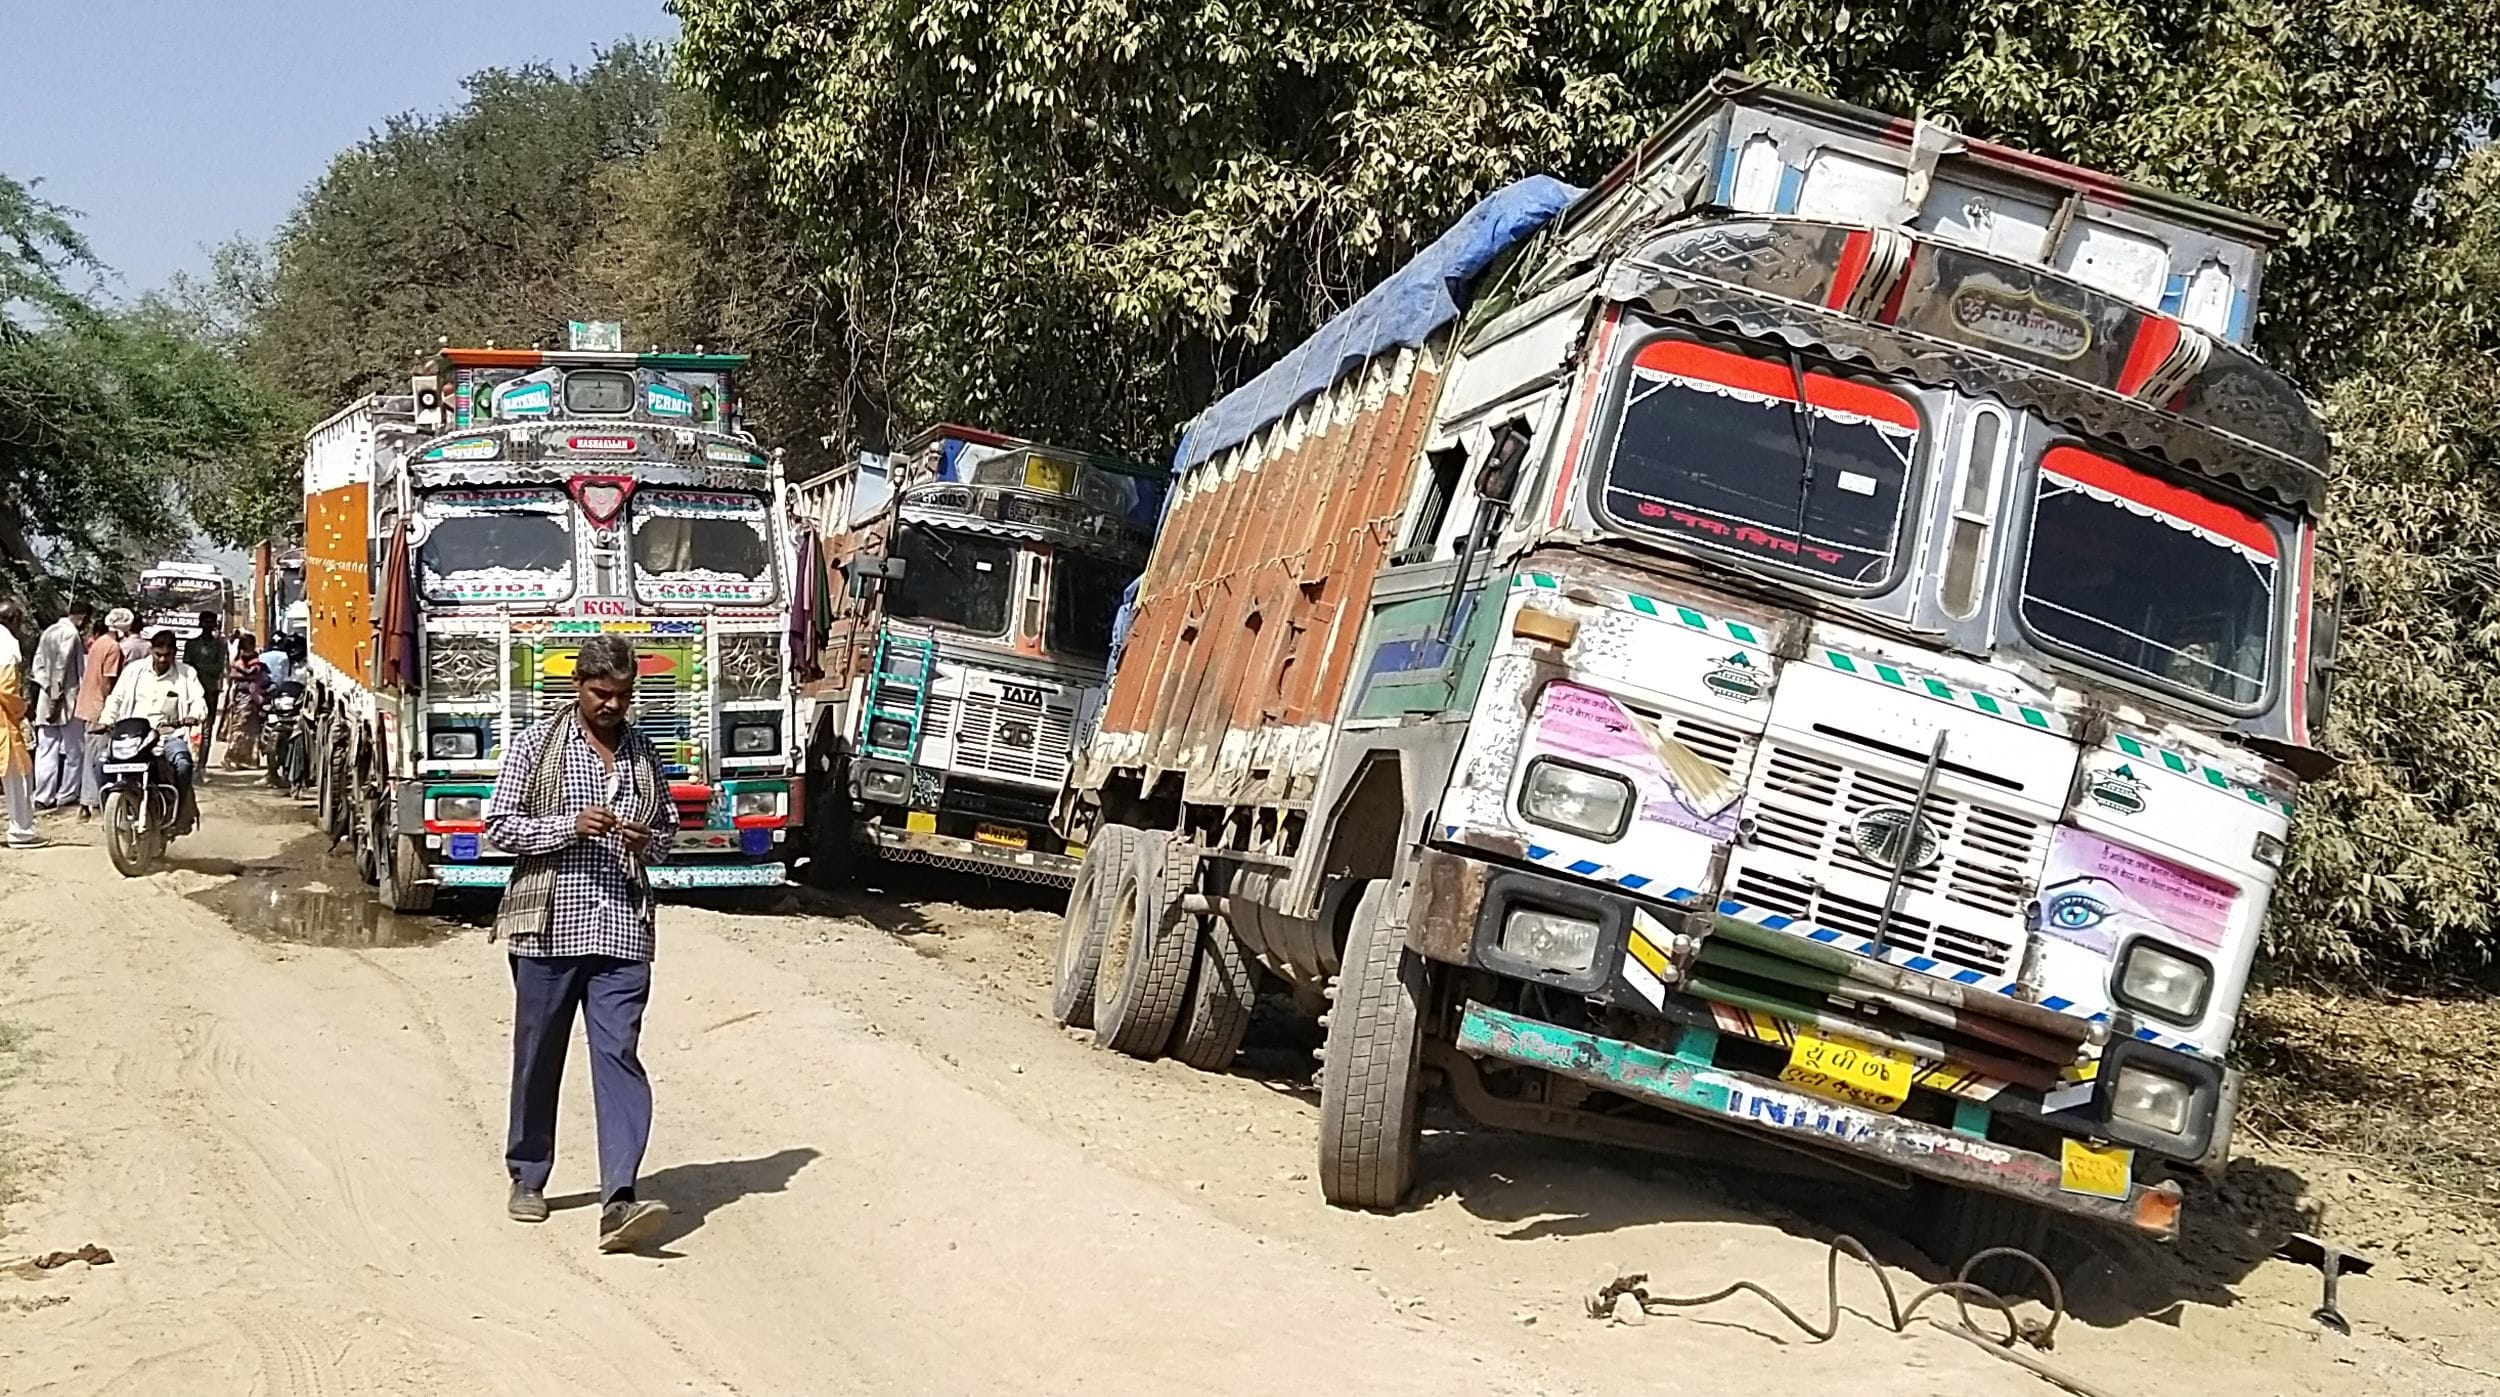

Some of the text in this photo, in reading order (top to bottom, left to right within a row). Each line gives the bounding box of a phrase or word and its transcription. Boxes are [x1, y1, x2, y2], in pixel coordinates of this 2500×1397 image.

[649, 392, 693, 414] PERMIT
[922, 494, 965, 508] GOODS
[1734, 526, 1844, 565] शिवय
[583, 601, 626, 615] KGN
[1001, 685, 1043, 706] TATA
